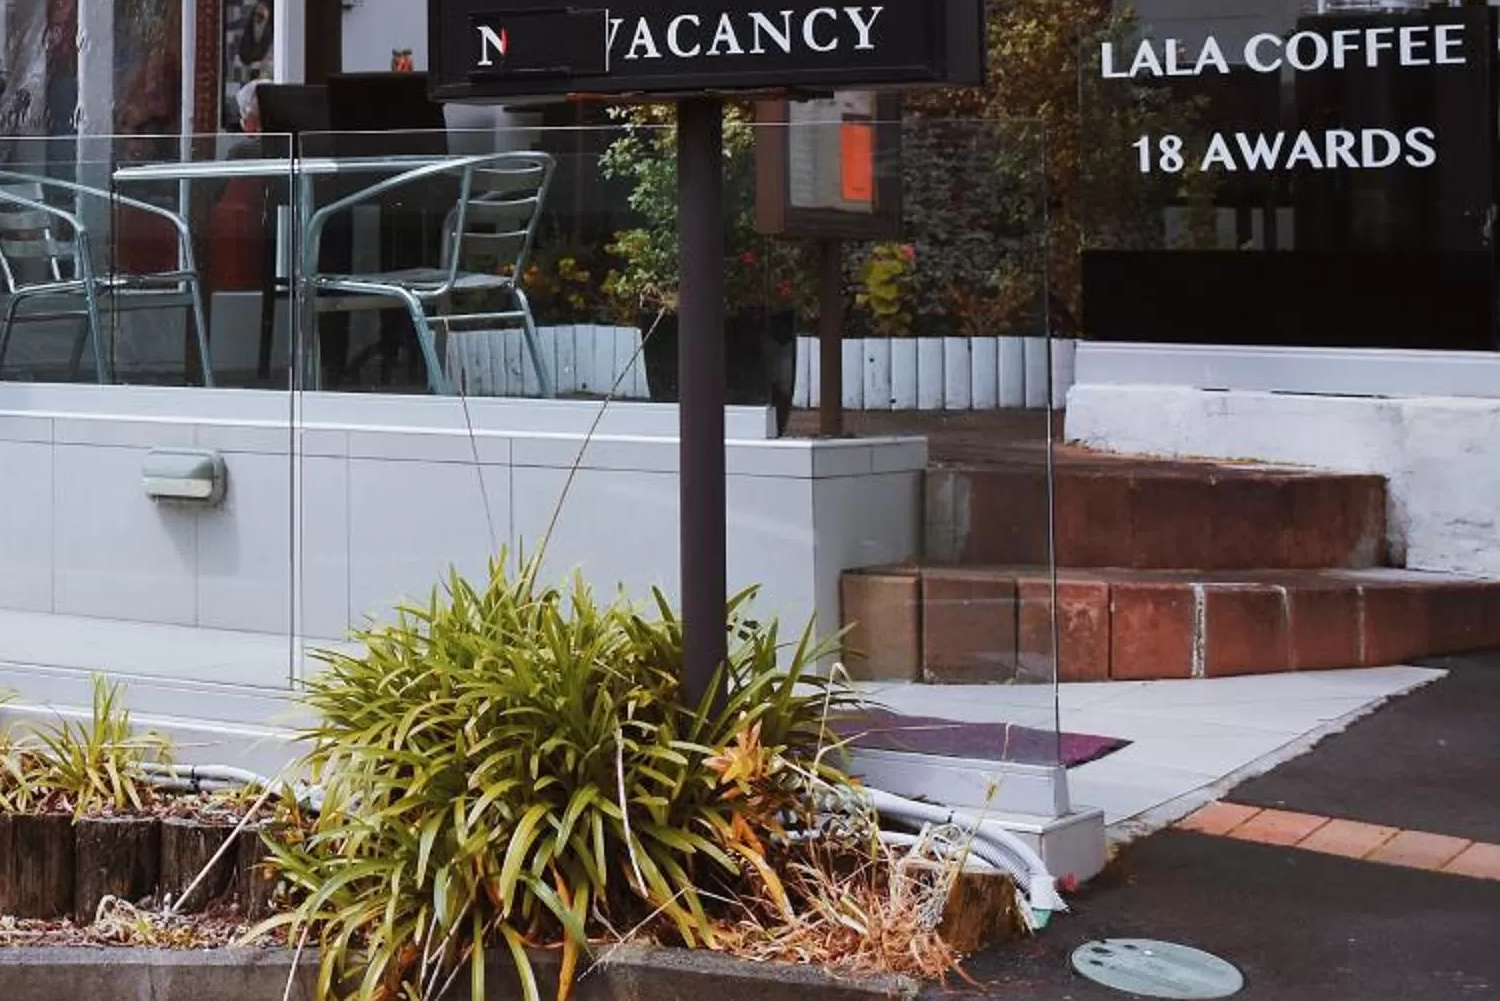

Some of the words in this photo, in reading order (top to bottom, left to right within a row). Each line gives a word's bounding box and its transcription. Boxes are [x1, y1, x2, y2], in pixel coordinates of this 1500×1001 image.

[1100, 37, 1228, 79] LALA
[1243, 23, 1467, 74] COFFEE
[1132, 133, 1183, 174] 18
[1200, 127, 1438, 173] AWARDS
